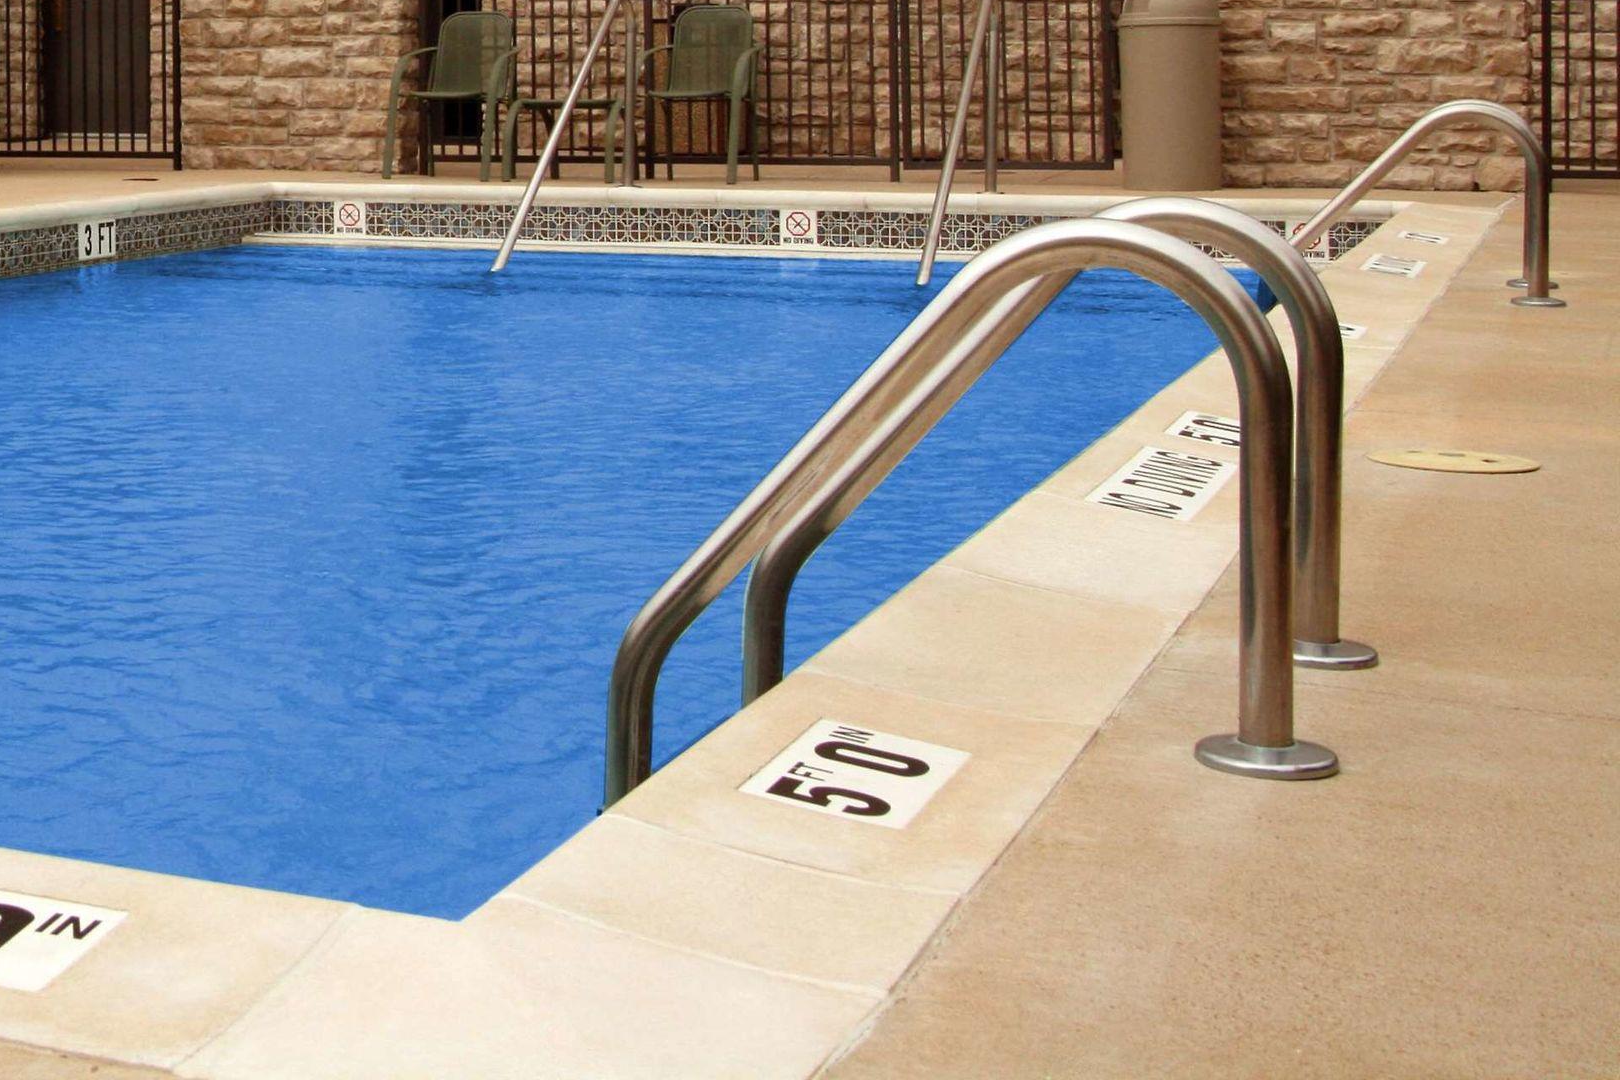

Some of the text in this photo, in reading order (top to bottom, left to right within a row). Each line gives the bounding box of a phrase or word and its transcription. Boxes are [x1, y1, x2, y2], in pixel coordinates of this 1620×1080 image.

[84, 222, 115, 257] 3 FT
[1097, 450, 1223, 520] NO DIVING
[765, 725, 930, 817] 5 FT 0 IN
[35, 912, 104, 940] IN
